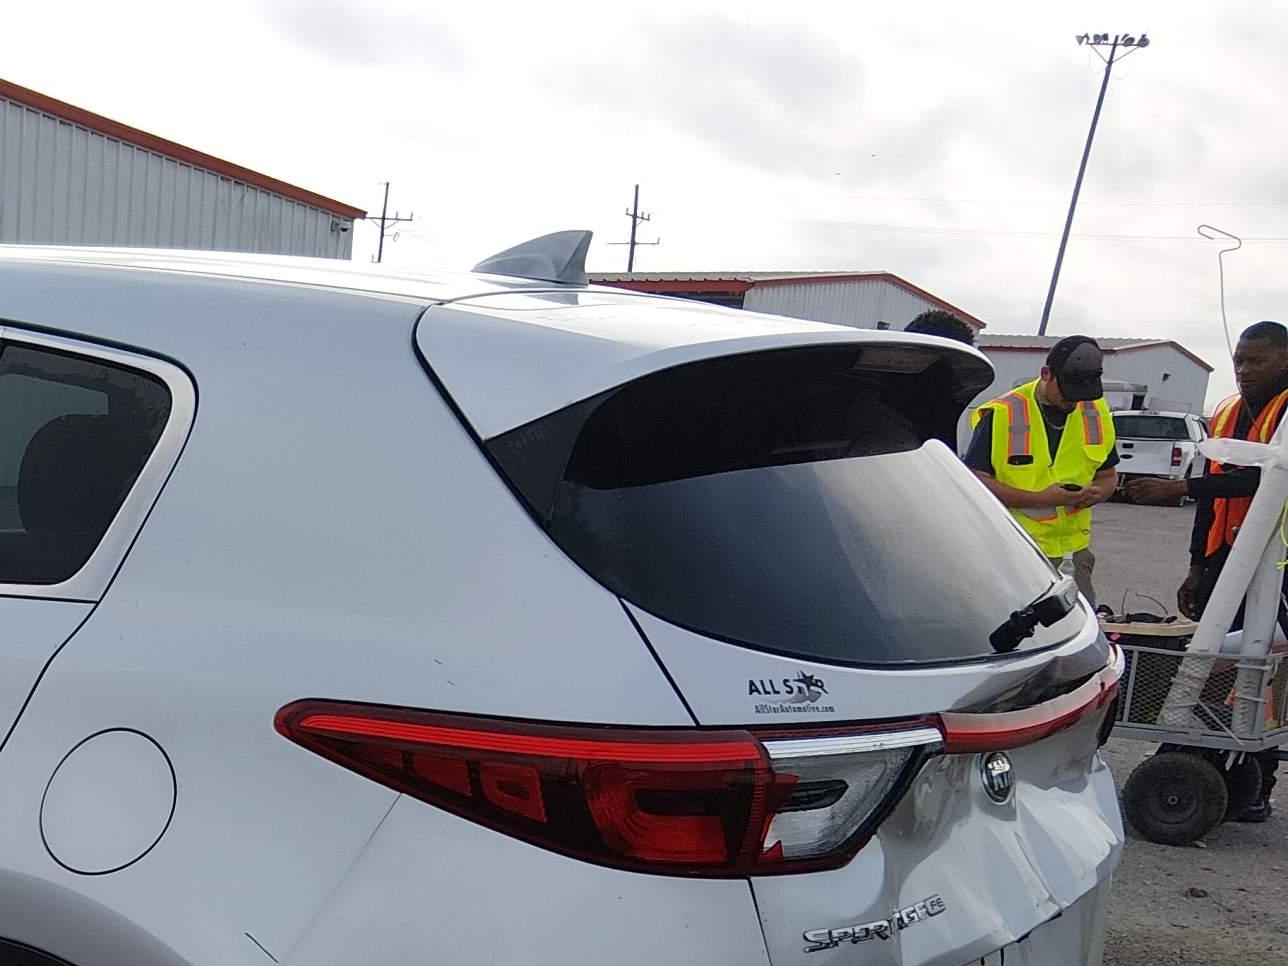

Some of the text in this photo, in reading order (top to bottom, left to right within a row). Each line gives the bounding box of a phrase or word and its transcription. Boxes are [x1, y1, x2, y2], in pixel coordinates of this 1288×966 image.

[748, 671, 829, 695] ALL STR
[755, 704, 835, 714] AllStarAutomotive.com
